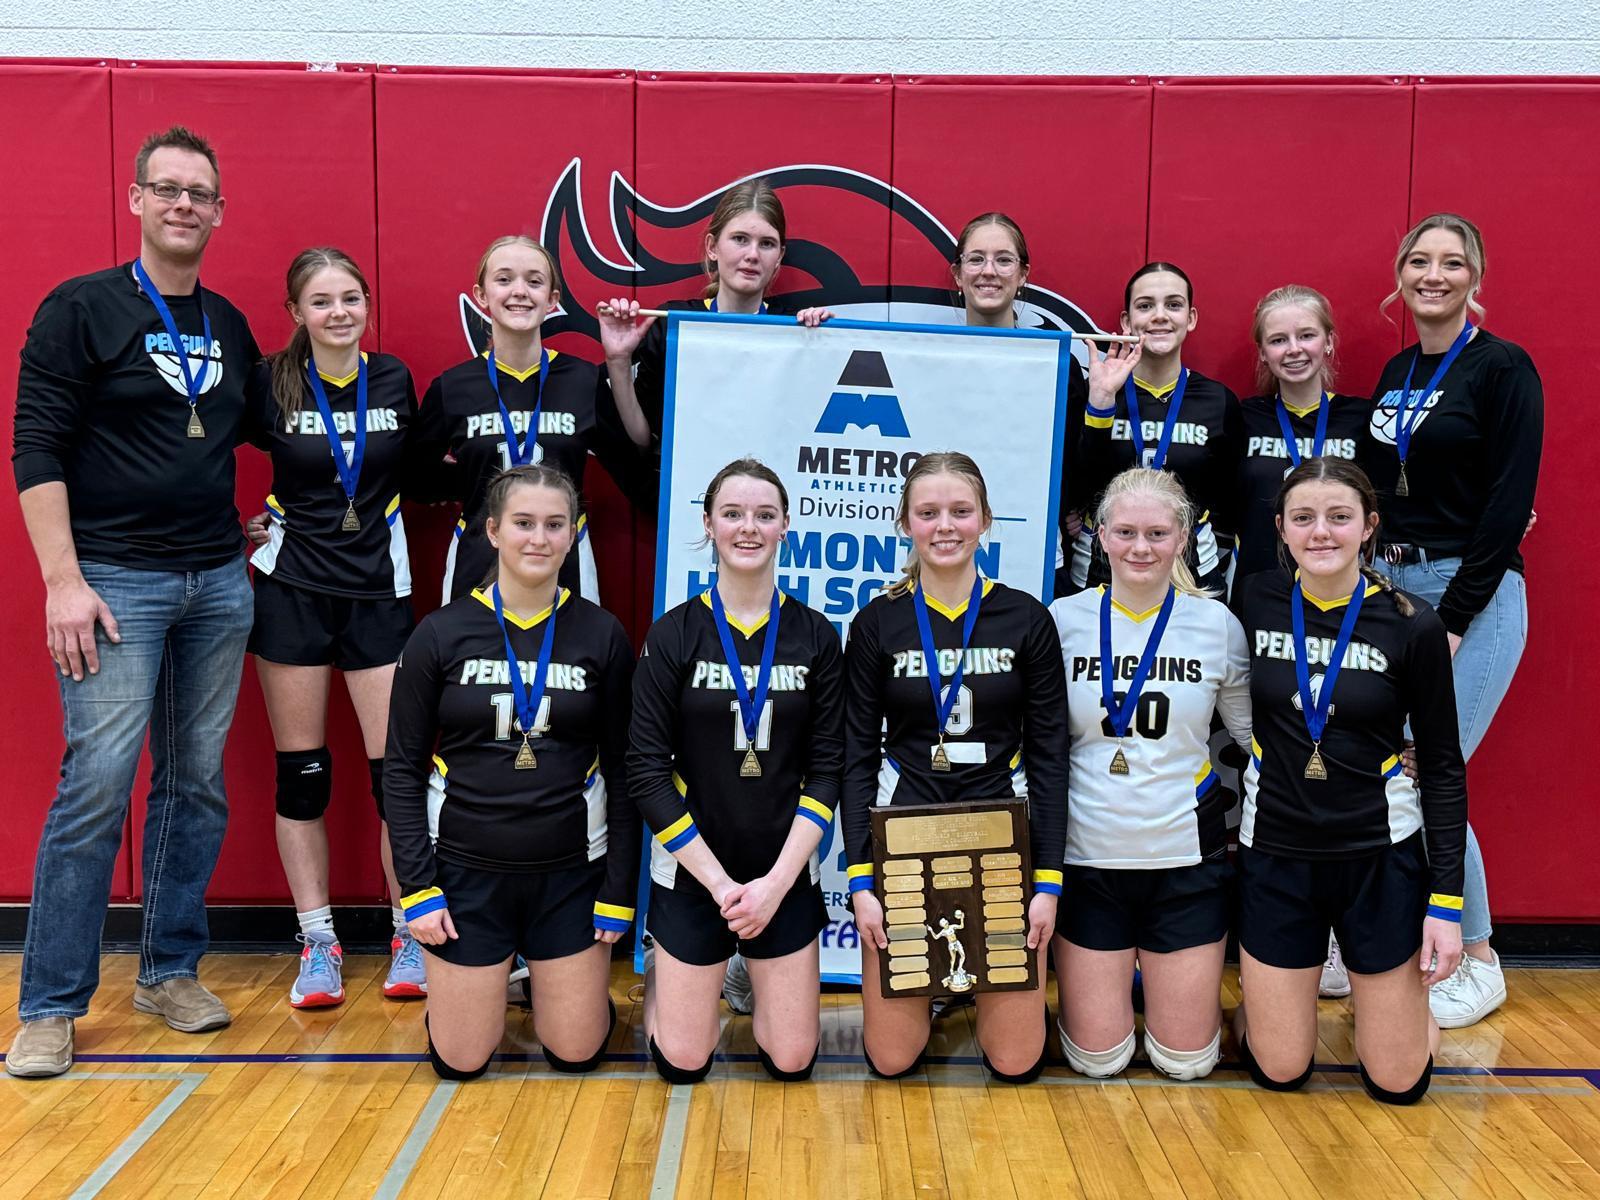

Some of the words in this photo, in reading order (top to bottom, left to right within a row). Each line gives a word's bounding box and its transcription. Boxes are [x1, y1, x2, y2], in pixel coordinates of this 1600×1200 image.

[1110, 418, 1209, 446] ENGUINS
[797, 445, 923, 479] METRO
[810, 478, 904, 495] ATHLETICS
[799, 496, 896, 522] Division
[490, 692, 552, 741] 14
[730, 699, 774, 751] 11
